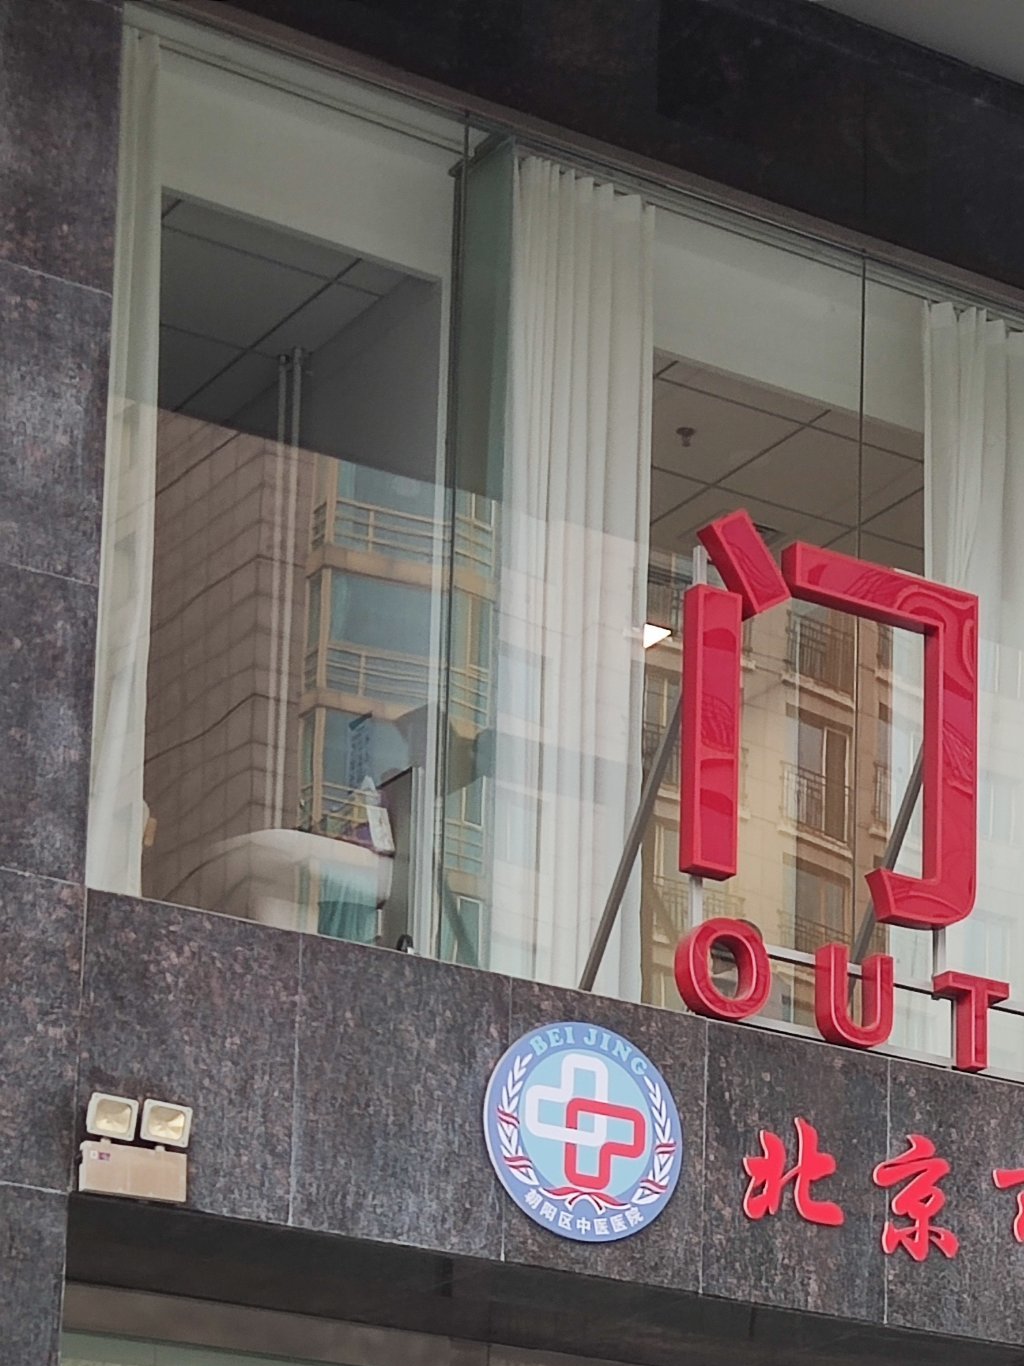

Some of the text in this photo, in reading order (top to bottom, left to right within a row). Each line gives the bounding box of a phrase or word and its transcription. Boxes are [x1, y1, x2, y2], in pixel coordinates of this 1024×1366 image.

[524, 1188, 645, 1236] 朝阳区中医医院
